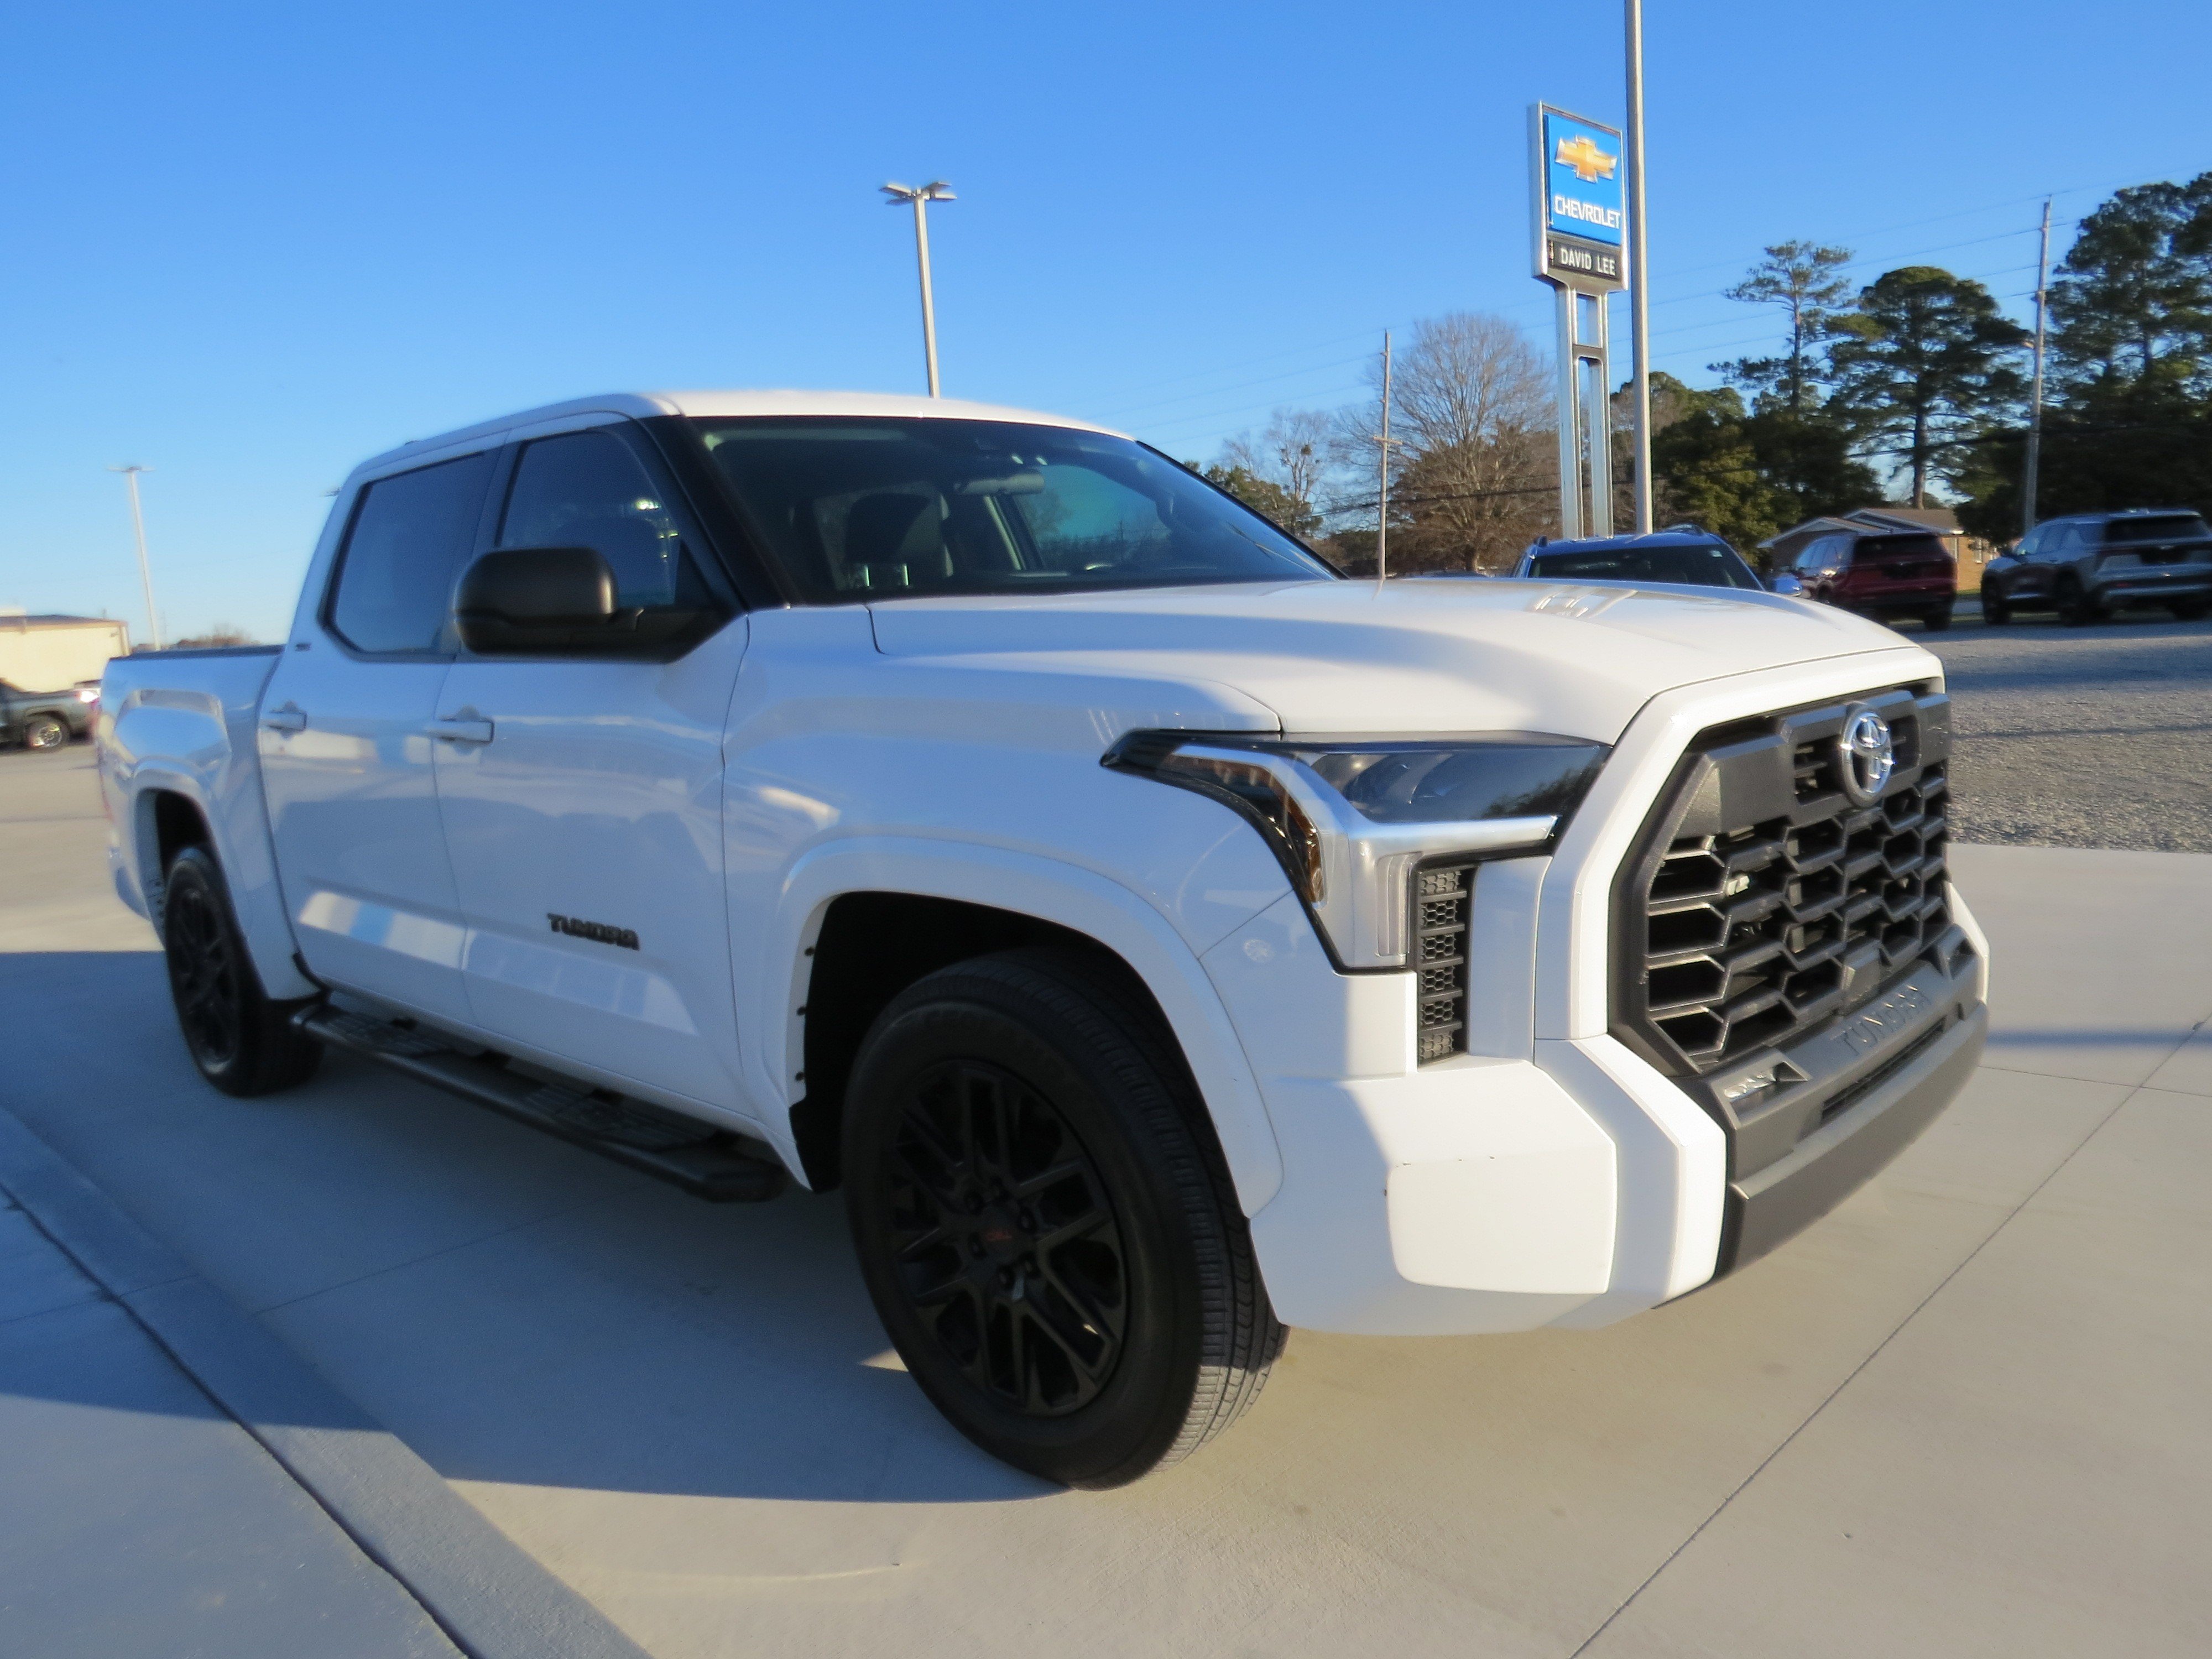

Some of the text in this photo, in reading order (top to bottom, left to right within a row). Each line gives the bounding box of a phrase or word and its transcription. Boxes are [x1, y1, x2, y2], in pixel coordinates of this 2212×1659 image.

[1554, 195, 1621, 229] CHEVROLET
[1561, 248, 1616, 276] DAVID LEE
[547, 912, 640, 951] TUNDRA
